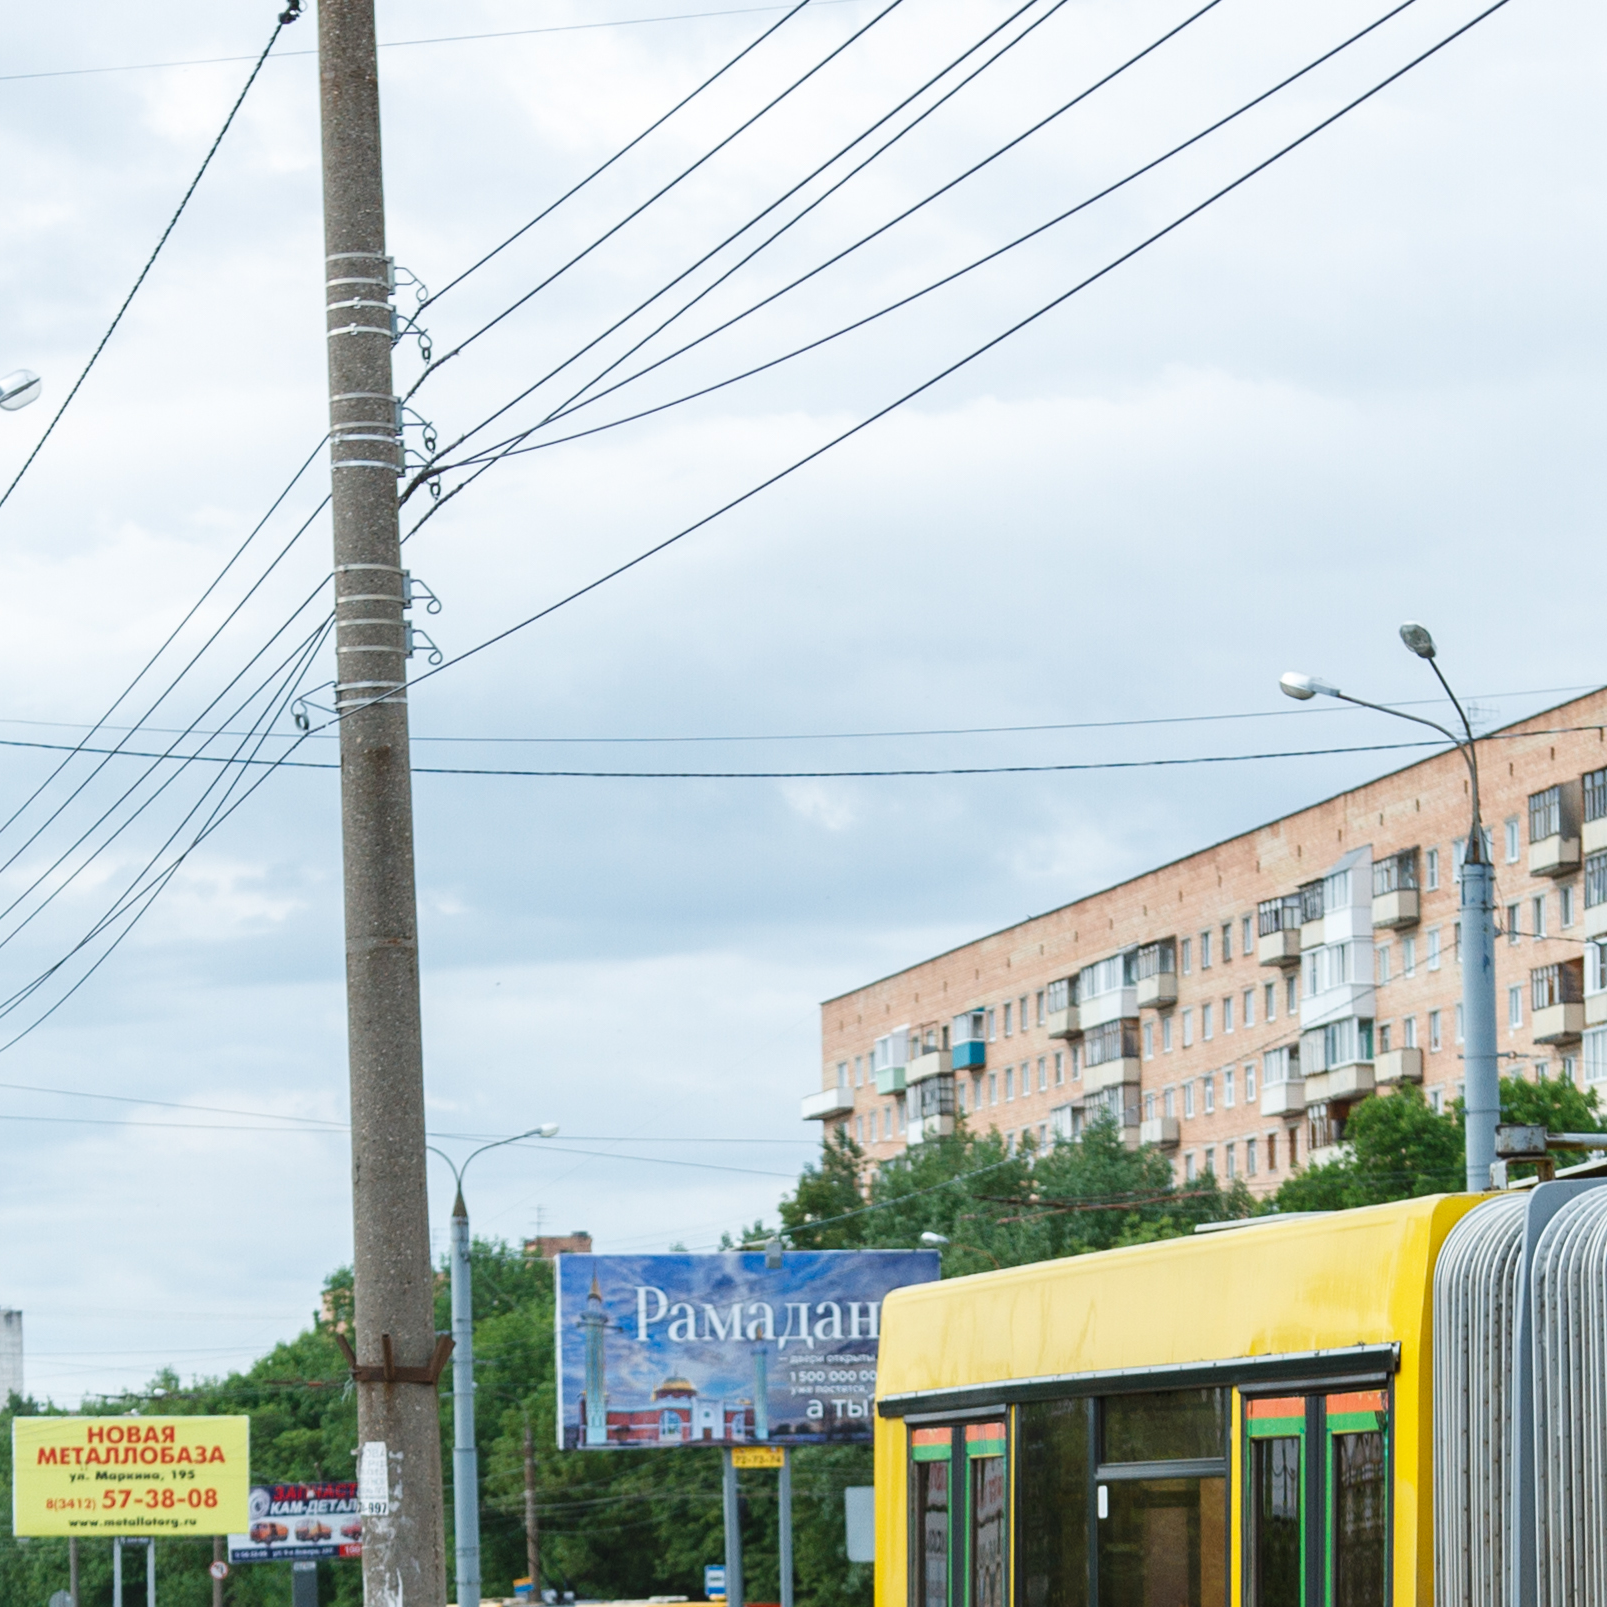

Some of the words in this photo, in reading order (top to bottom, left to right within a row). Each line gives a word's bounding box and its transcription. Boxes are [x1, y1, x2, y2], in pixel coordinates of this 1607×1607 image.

[634, 1286, 880, 1350] Рамадан
[798, 1371, 826, 1383] 500
[828, 1370, 857, 1383] 000
[806, 1399, 824, 1418] а
[87, 1426, 176, 1444] НОВАЯ
[37, 1445, 226, 1466] МЕТАЛЛОБАЗА
[70, 1472, 90, 1482] ул.
[95, 1471, 165, 1482] Маркина,
[171, 1470, 196, 1480] 195
[46, 1498, 96, 1512] 8(3412)
[102, 1488, 219, 1509] 57-38-08
[270, 1498, 358, 1516] КАМ-ДЕТАЛ
[69, 1516, 197, 1528] www.metallotorg.ru
